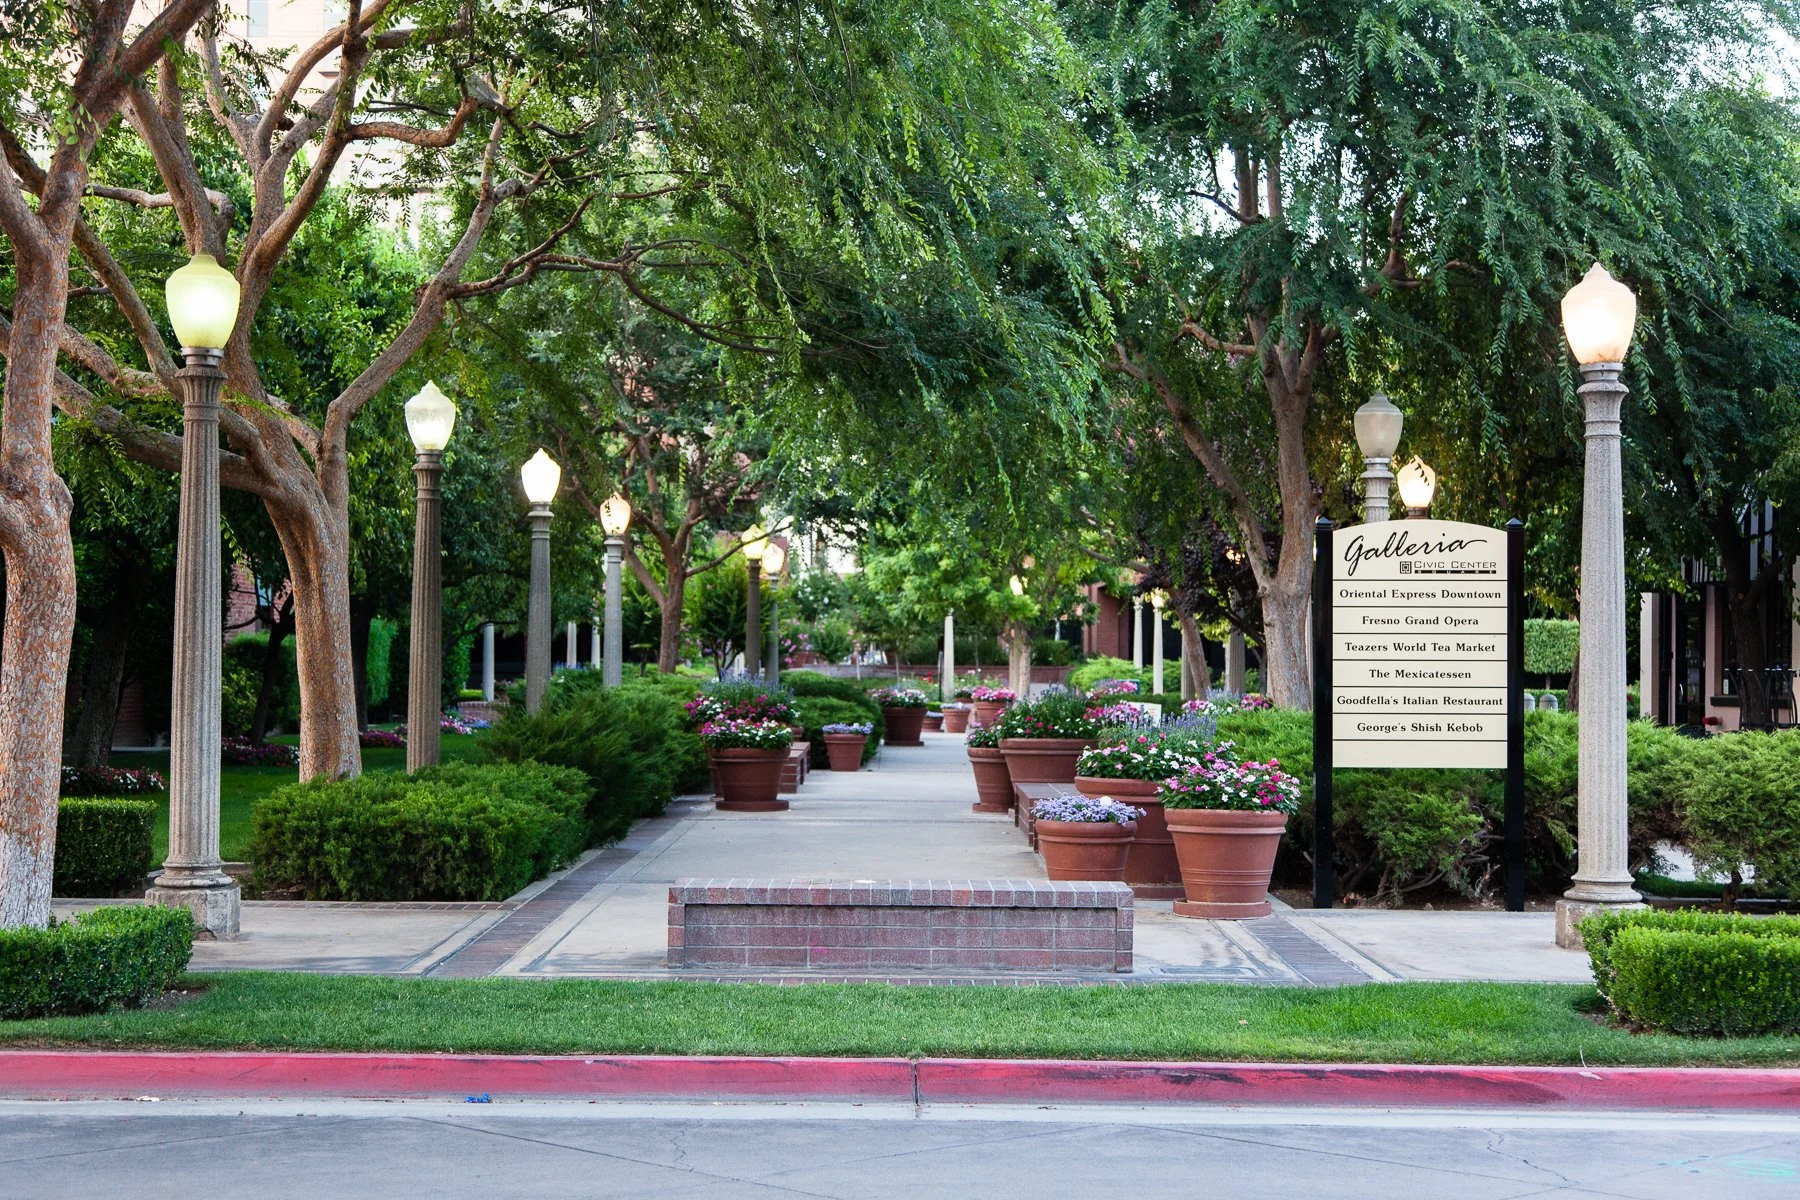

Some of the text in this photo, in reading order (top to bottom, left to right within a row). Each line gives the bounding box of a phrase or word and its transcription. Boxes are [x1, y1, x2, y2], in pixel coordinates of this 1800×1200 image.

[1344, 531, 1488, 577] Galleria
[1414, 561, 1497, 569] CIVIC CENTER
[1339, 588, 1502, 600] Oriental Express Downtown
[1362, 615, 1479, 628] Fresno Grand Opera
[1345, 642, 1496, 652] Teazers World Tea Market
[1369, 669, 1472, 679] The Mexicatessen
[1336, 695, 1503, 706] Goodfella's Italian Restaurant
[1357, 722, 1484, 734] George's Shish Kebob
